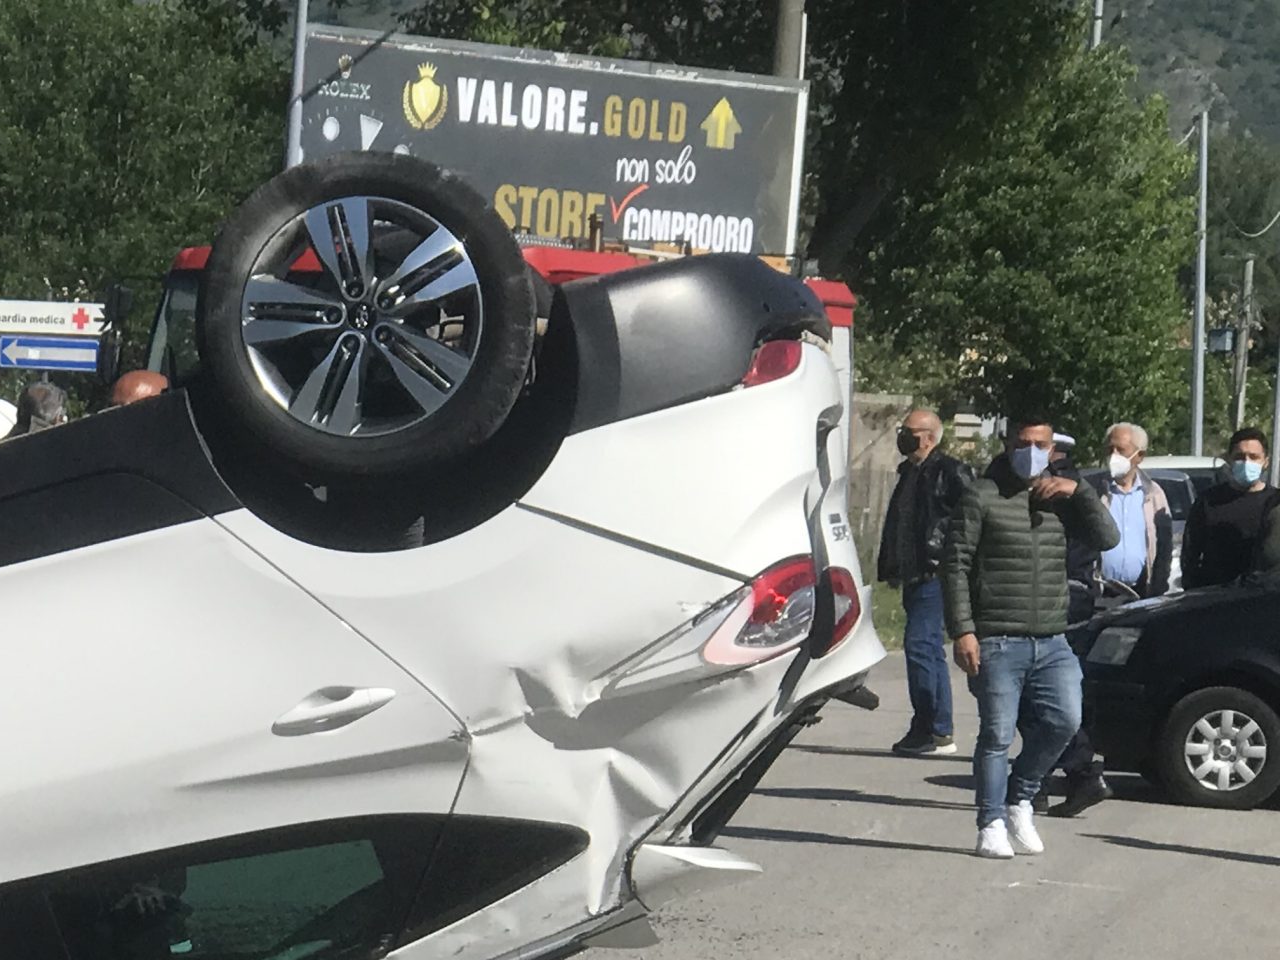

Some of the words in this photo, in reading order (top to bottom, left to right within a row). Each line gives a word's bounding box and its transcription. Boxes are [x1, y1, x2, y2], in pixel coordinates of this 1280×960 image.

[616, 157, 649, 183] non
[655, 145, 696, 184] solo
[622, 206, 754, 254] COMPROORO
[29, 314, 66, 325] medica
